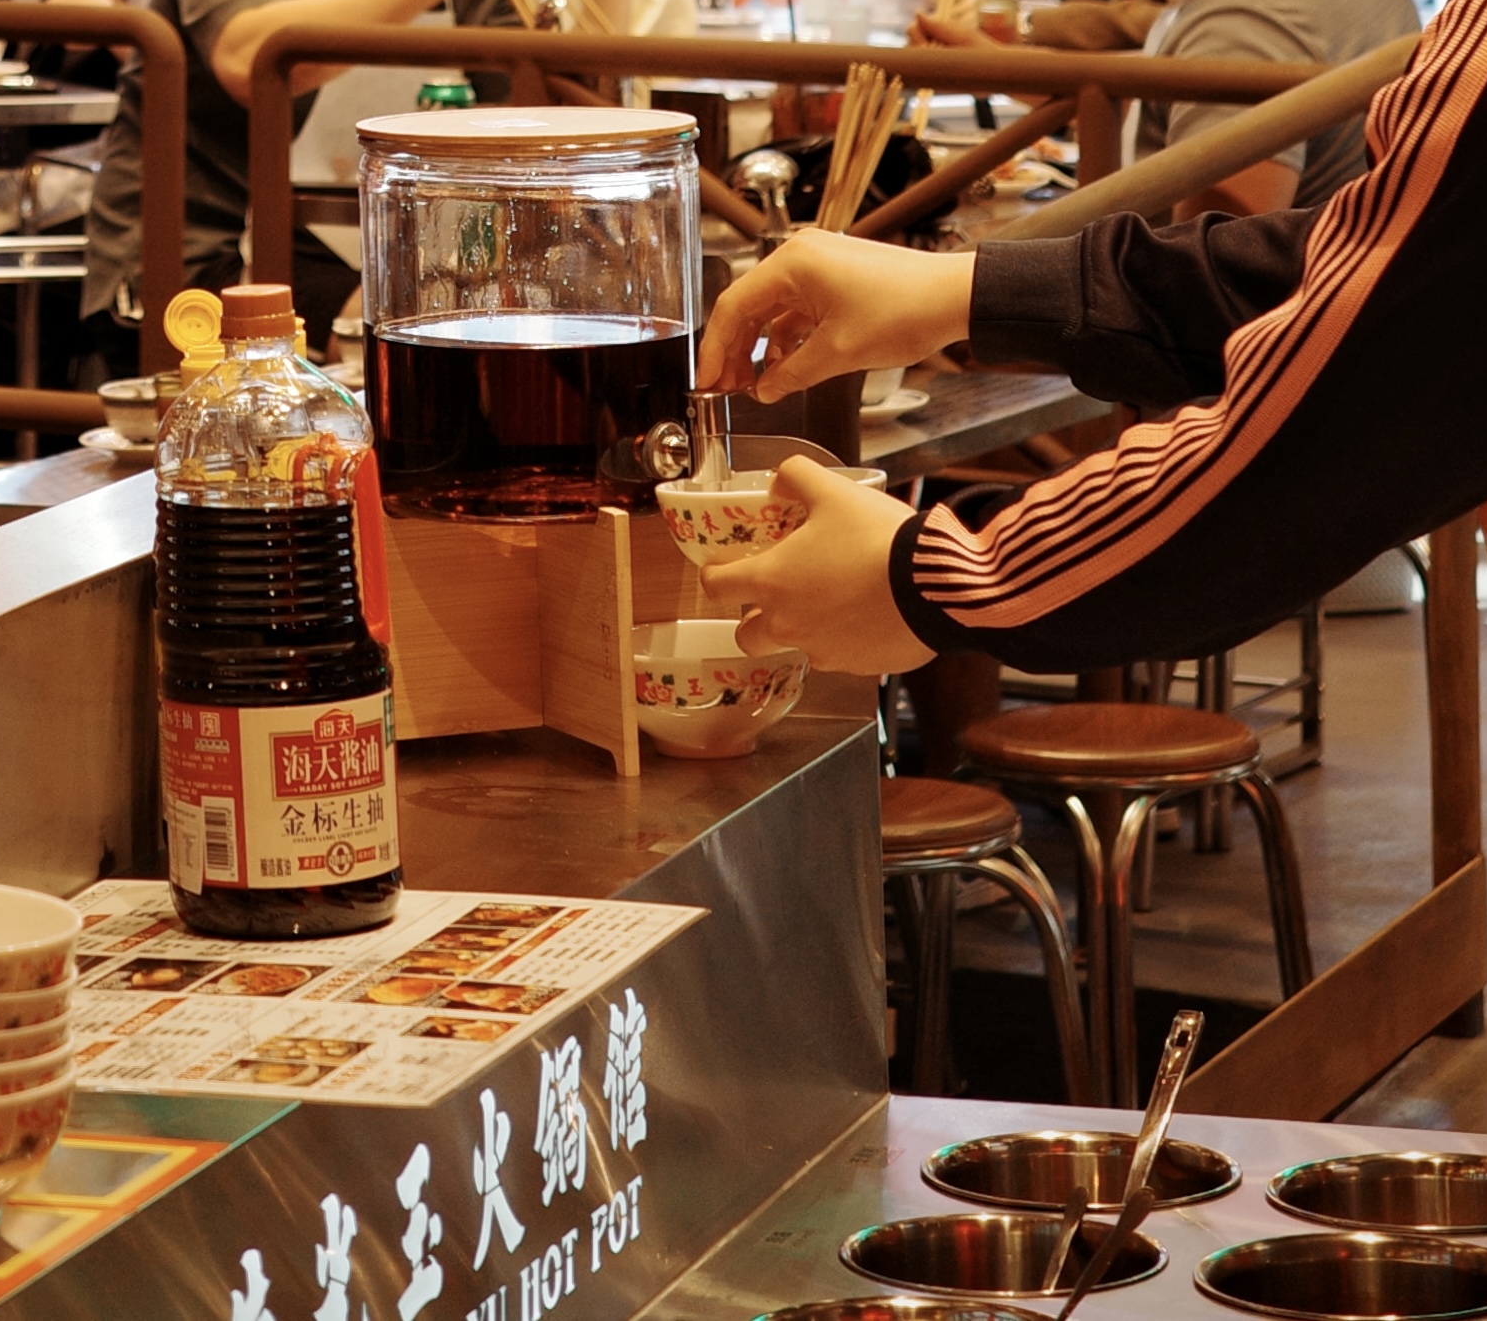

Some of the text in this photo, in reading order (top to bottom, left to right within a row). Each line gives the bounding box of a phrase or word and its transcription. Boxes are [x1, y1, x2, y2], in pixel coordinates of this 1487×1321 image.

[318, 717, 352, 739] 海天
[281, 734, 381, 786] 海天酱油
[330, 780, 347, 791] SOY
[279, 791, 385, 838] 金标生抽
[519, 1227, 580, 1321] HOT
[589, 1175, 643, 1274] POT
